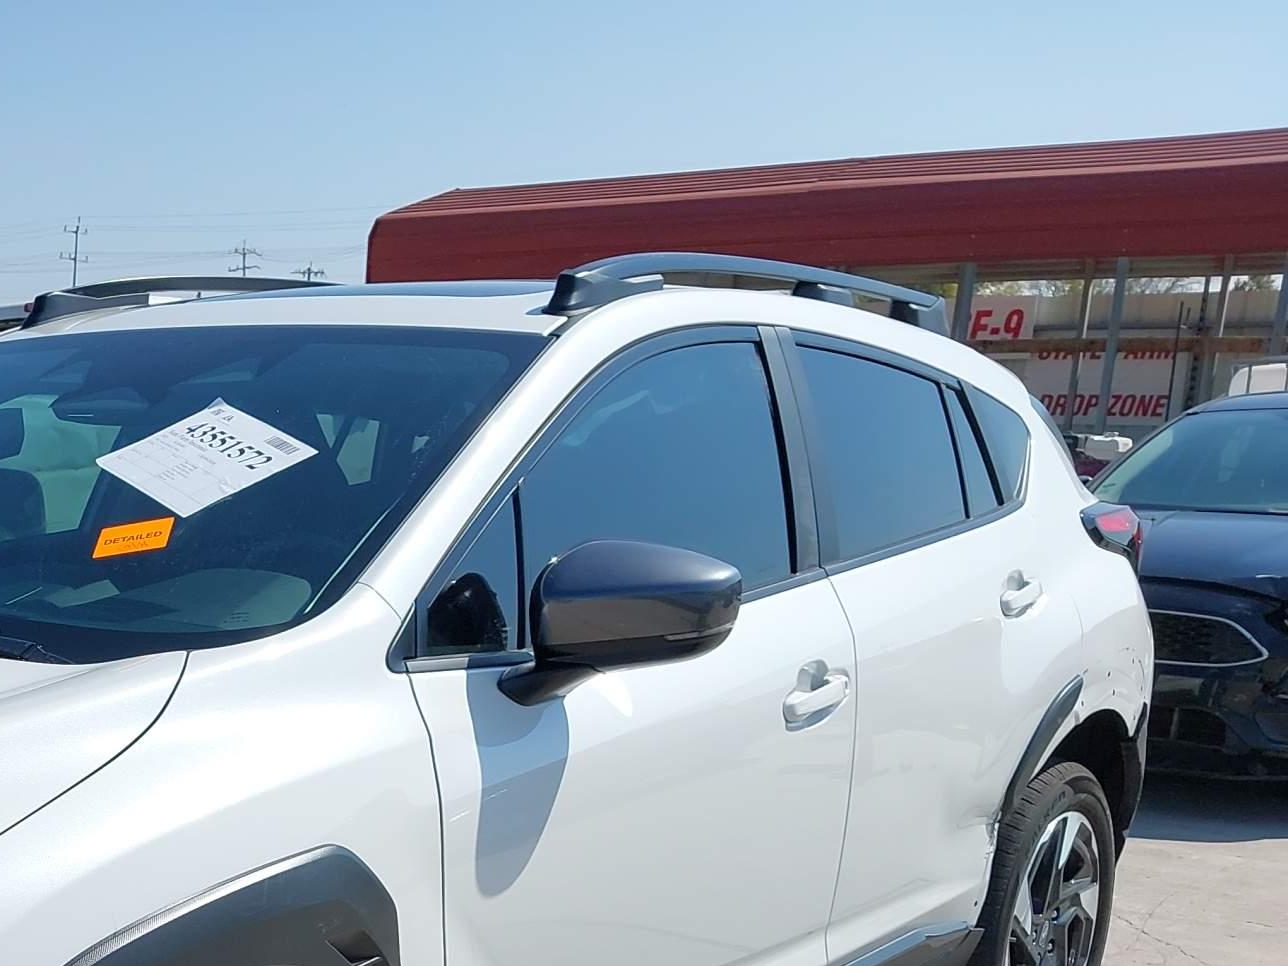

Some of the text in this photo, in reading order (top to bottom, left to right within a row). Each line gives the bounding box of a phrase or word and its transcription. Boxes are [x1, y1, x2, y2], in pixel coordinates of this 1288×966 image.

[969, 308, 1024, 340] F-9
[1041, 394, 1169, 417] DROP ZONE
[184, 422, 274, 470] 43551572
[103, 530, 163, 546] DETAILED
